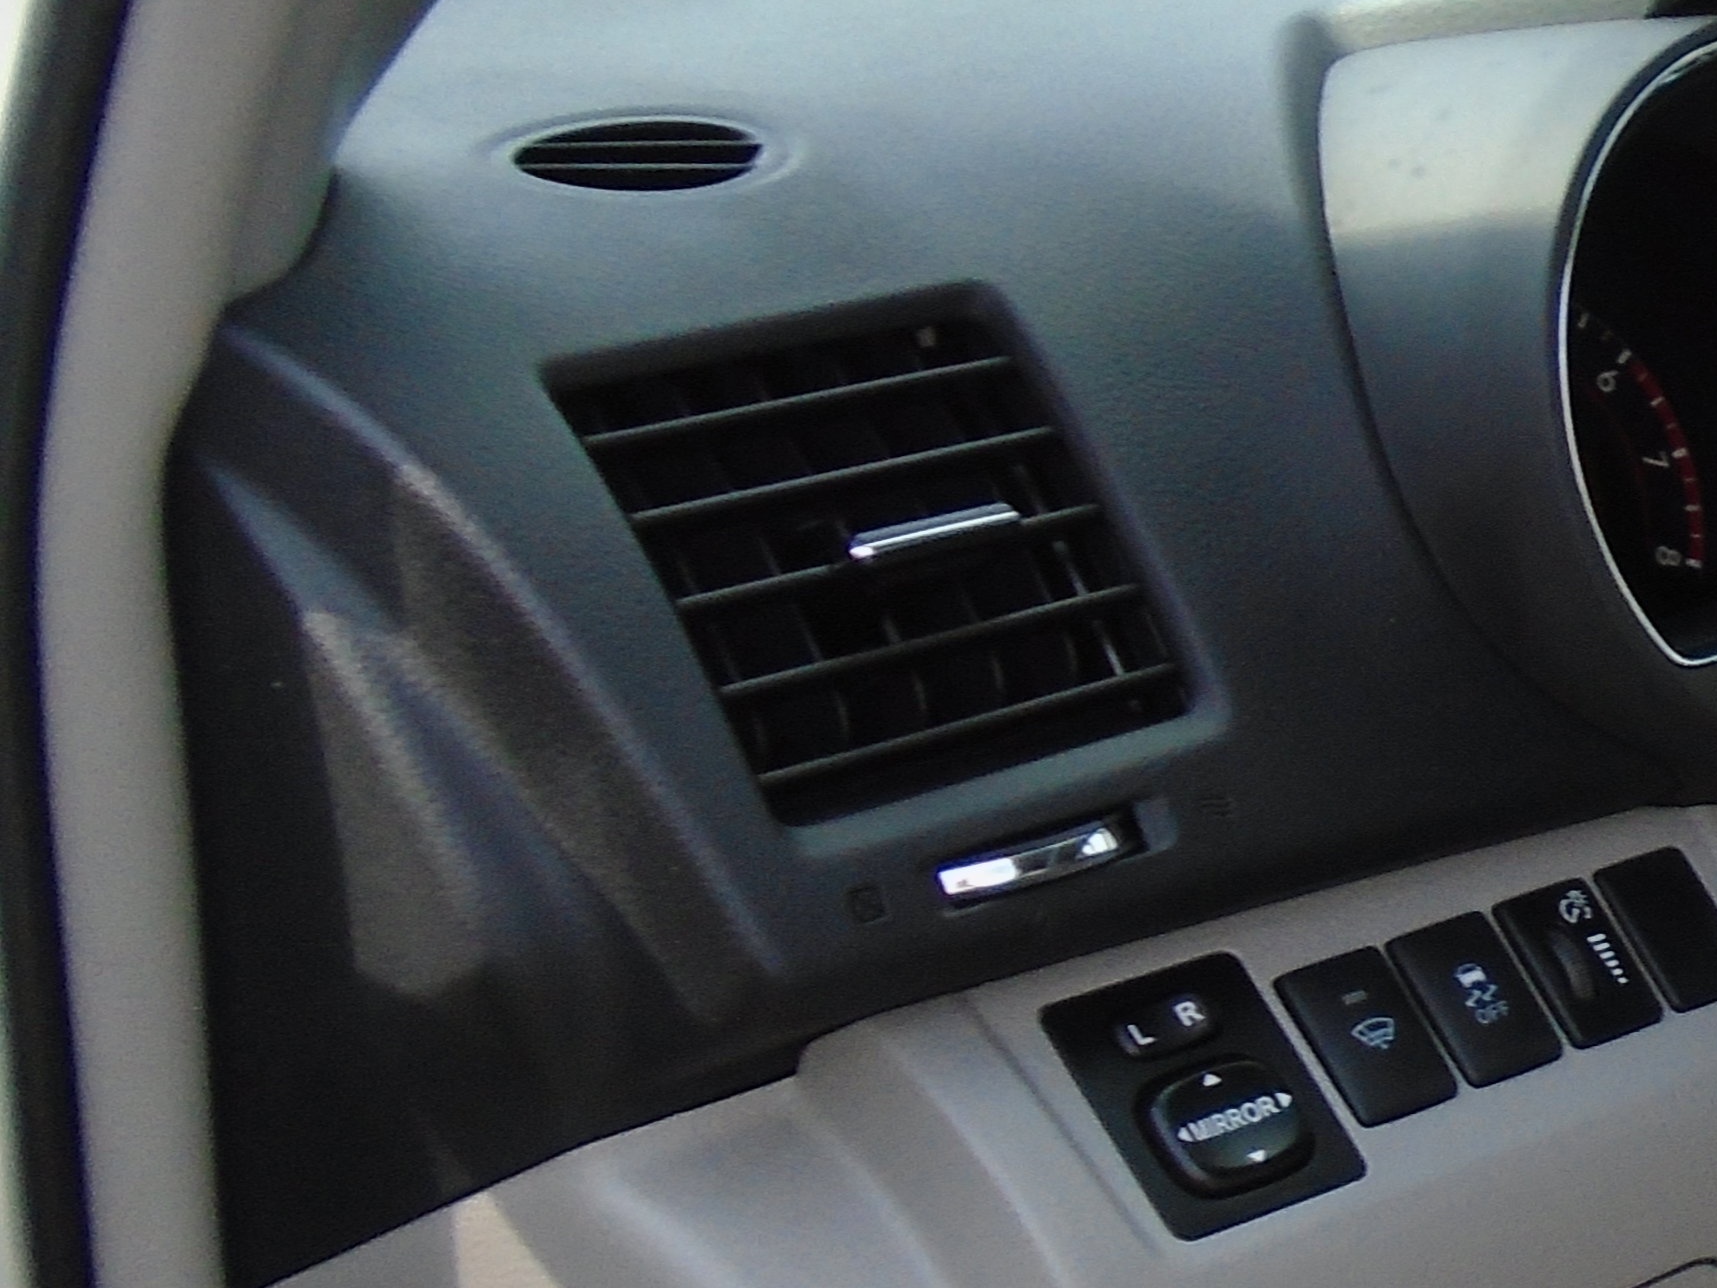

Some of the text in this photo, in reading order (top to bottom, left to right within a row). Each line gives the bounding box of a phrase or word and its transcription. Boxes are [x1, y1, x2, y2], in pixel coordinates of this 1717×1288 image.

[1596, 369, 1619, 392] 6
[1641, 450, 1670, 468] 7
[1655, 545, 1682, 566] 8
[1127, 1000, 1206, 1045] L R
[1187, 1096, 1281, 1142] MIRROR
